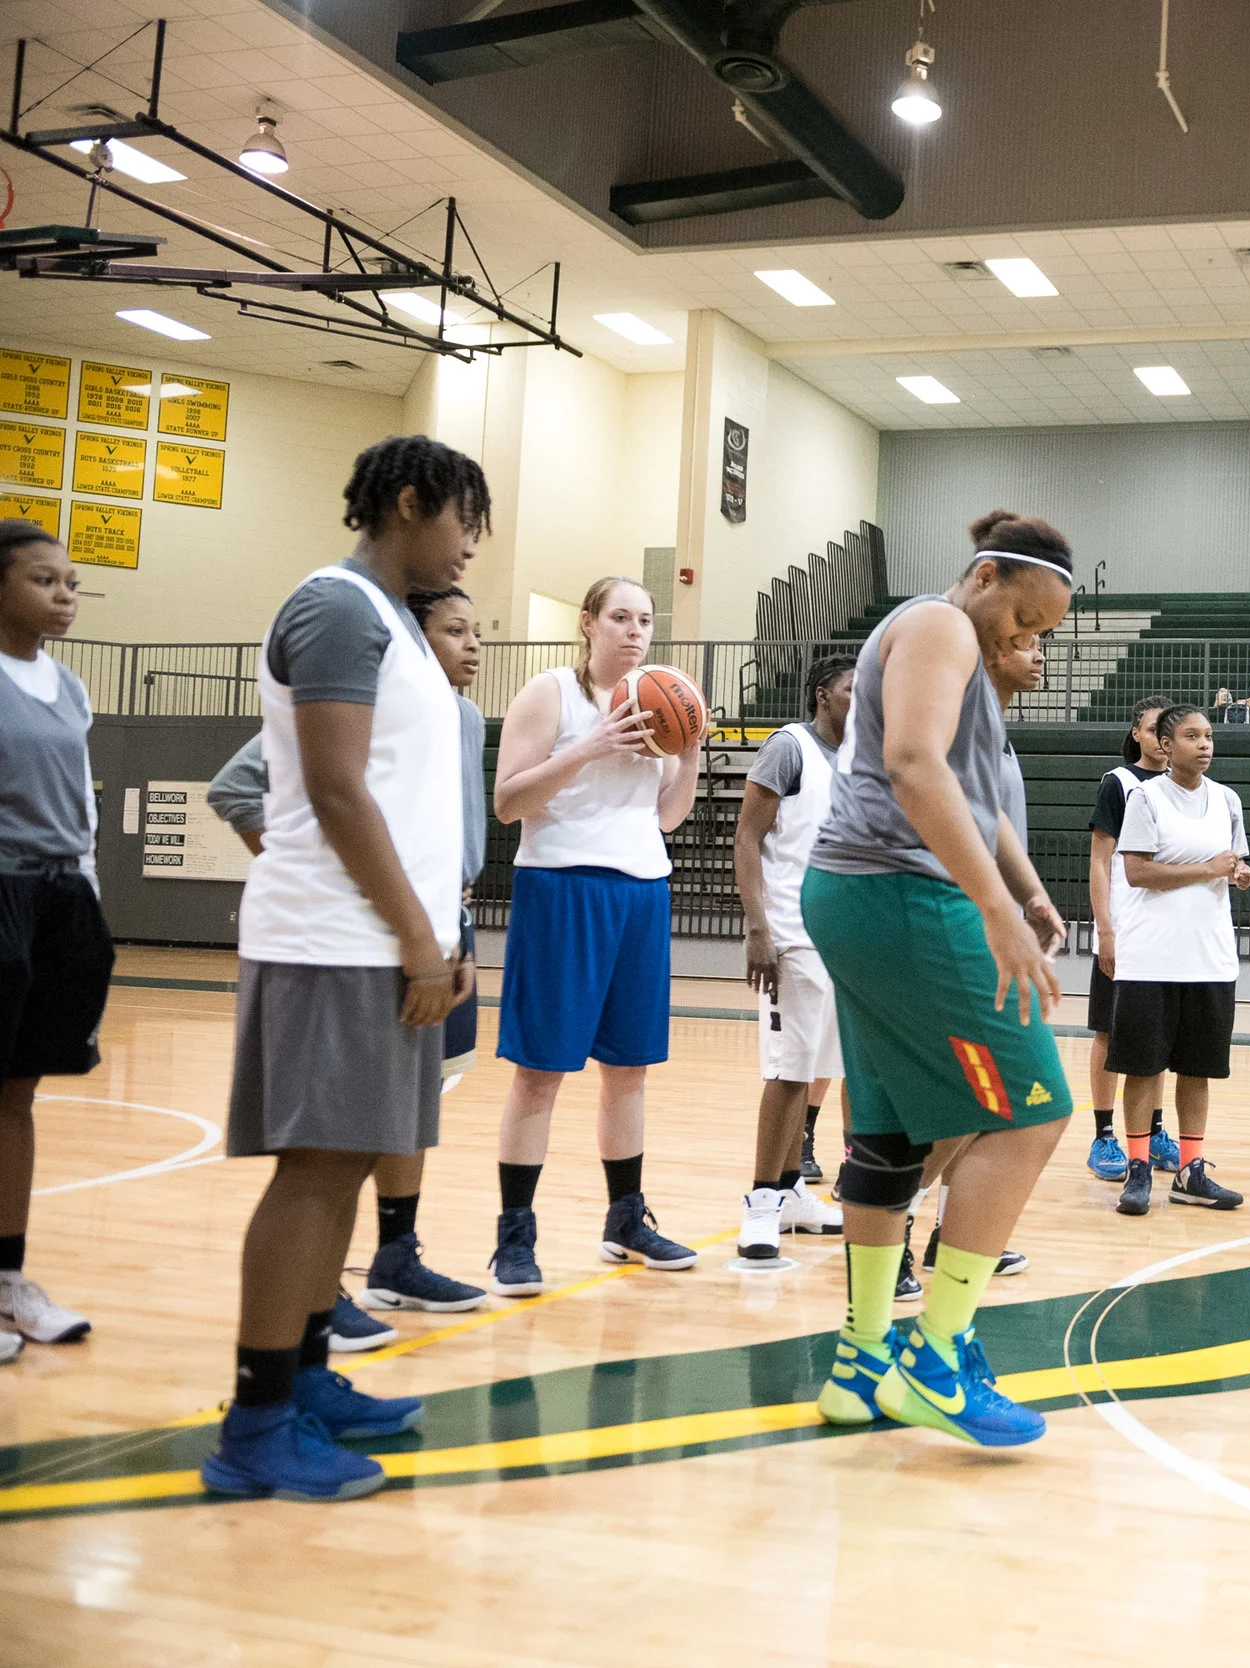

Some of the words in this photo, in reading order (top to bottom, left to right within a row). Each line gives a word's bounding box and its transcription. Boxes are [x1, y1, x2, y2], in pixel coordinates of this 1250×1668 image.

[24, 355, 44, 363] VALLEY
[85, 365, 105, 373] SPRING
[106, 367, 125, 376] VALLEY
[127, 371, 149, 379] VIKINGS
[19, 375, 38, 383] CROSS
[39, 378, 65, 387] COUNTRY
[165, 376, 185, 384] SPRING
[185, 380, 204, 388] VALLEY
[206, 383, 226, 391] VIKINGS
[85, 384, 104, 393] GIRLS
[105, 387, 146, 399] BASKETBALL
[3, 402, 22, 410] STATE
[25, 405, 49, 413] RUNNER
[167, 397, 185, 405] GIRLS
[187, 400, 222, 410] SWIMMING
[18, 426, 38, 434] VALLEY
[41, 429, 62, 437] VIKINGS
[80, 434, 99, 442] SPRING
[101, 437, 120, 445] VALLEY
[122, 440, 143, 448] VIKINGS
[13, 446, 32, 454] CROSS
[33, 448, 61, 457] COUNTRY
[160, 444, 179, 452] SPRING
[181, 447, 200, 455] VALLEY
[202, 450, 222, 458] VIKINGS
[80, 454, 97, 462] BOYS
[99, 457, 140, 468] BASKETBALL
[170, 466, 210, 476] VOLLEYBALL
[20, 476, 45, 484] RUNNER
[95, 485, 111, 493] STATE
[112, 487, 139, 496] CHAMPIONS
[13, 497, 34, 505] VALLEY
[35, 499, 58, 507] VIKINGS
[157, 492, 174, 500] LOWER
[191, 497, 218, 505] CHAMPIONS
[75, 503, 94, 511] SPRING
[96, 506, 115, 514] VALLEY
[85, 525, 103, 533] BOYS
[104, 527, 125, 535] TRACK
[670, 683, 698, 735] molten
[149, 793, 186, 803] BELLWORK
[148, 813, 185, 824] OBJECTIVES
[146, 834, 160, 845] TODAY
[161, 835, 170, 845] WE
[145, 854, 182, 865] HOMEWORK
